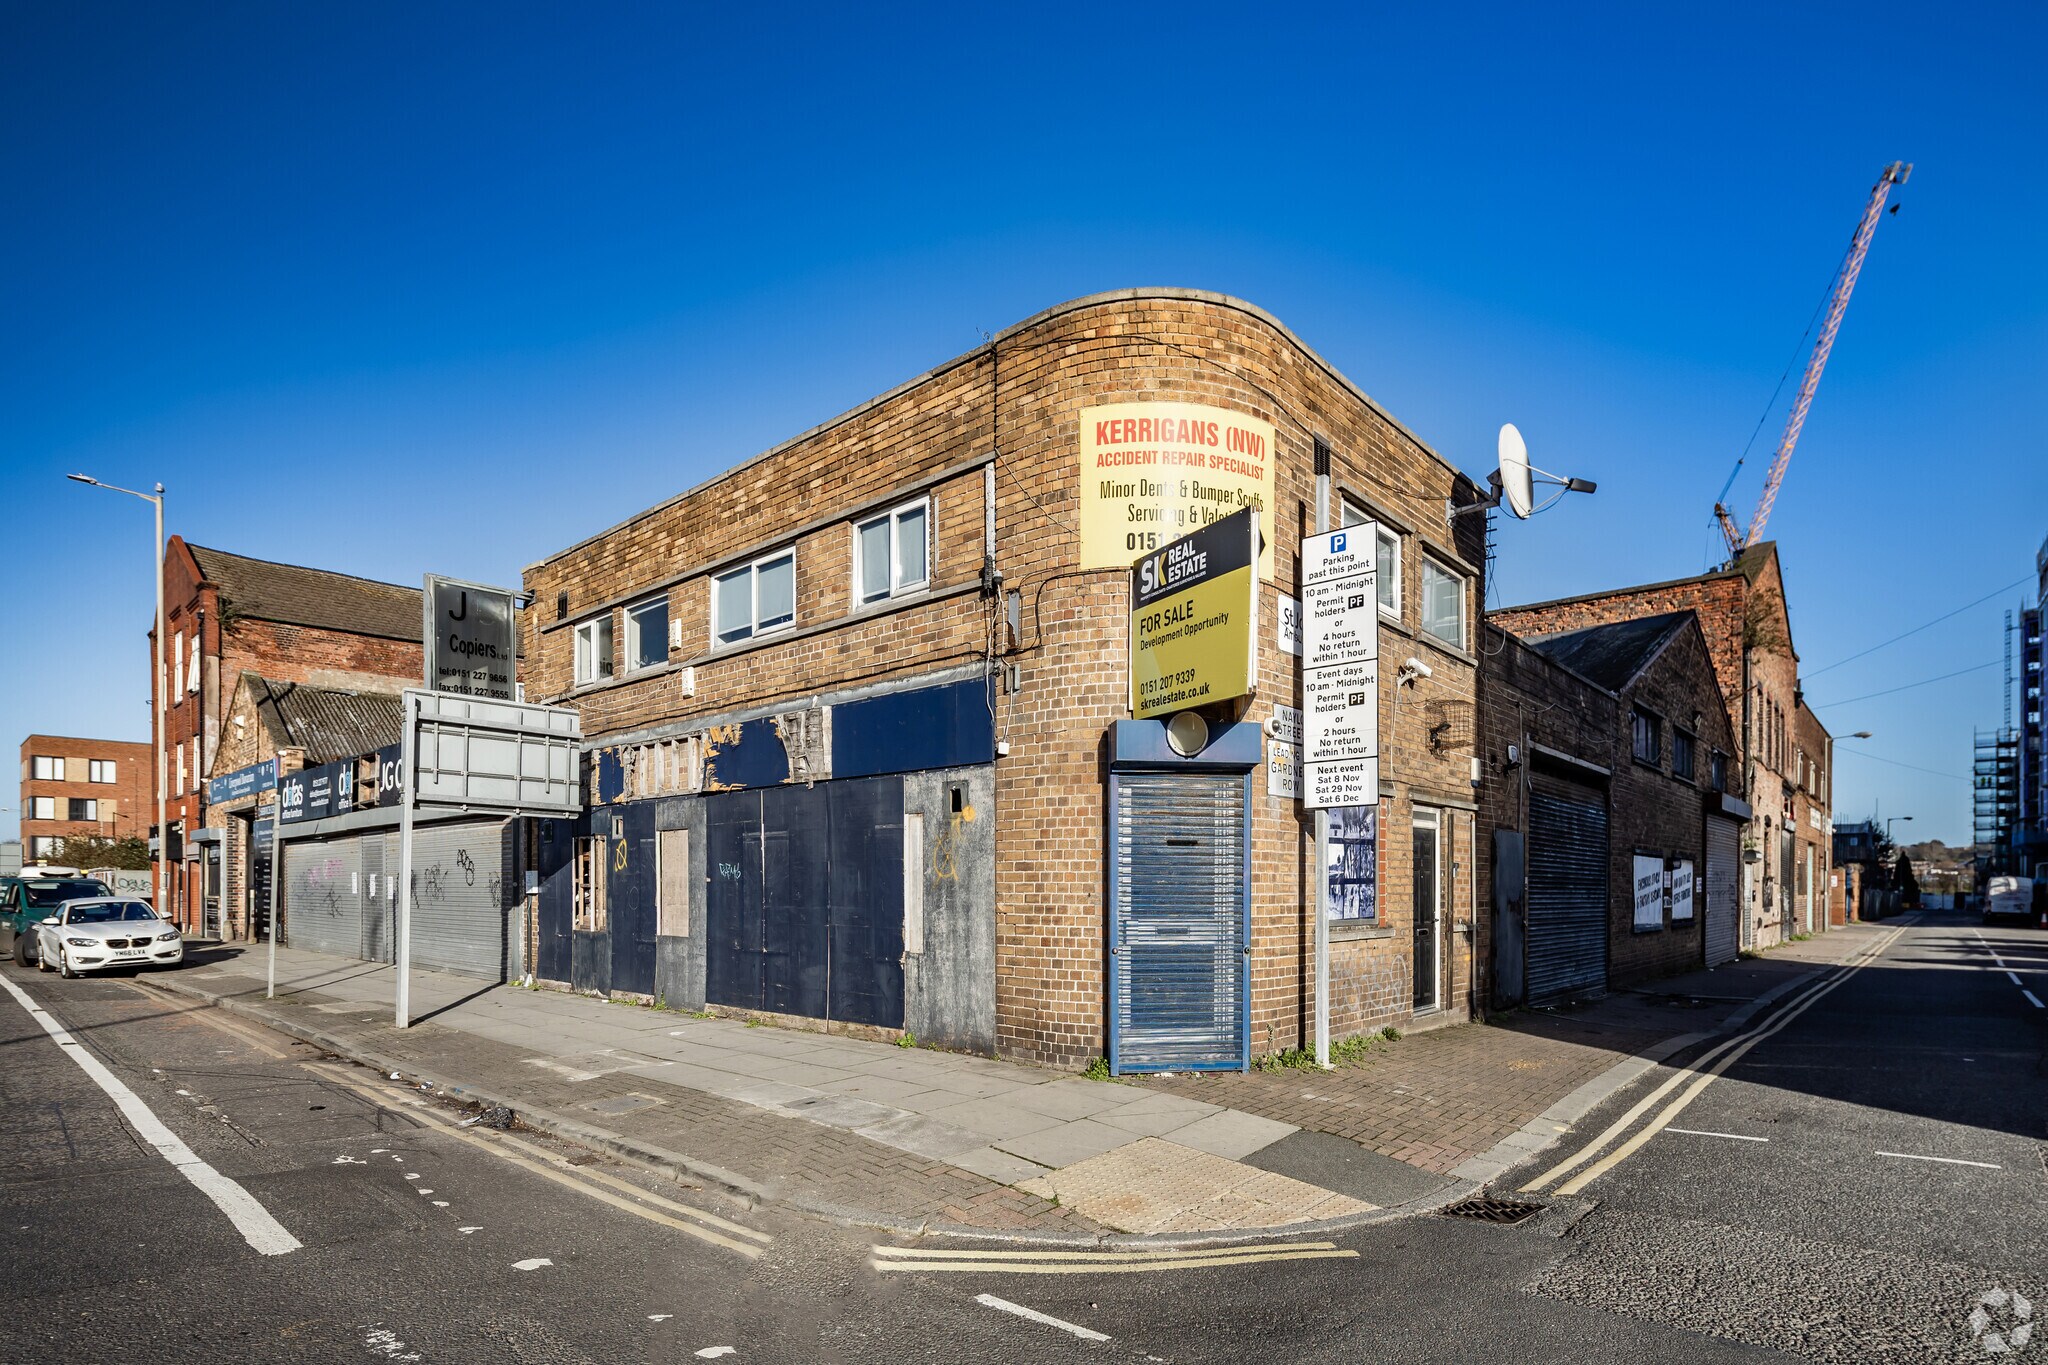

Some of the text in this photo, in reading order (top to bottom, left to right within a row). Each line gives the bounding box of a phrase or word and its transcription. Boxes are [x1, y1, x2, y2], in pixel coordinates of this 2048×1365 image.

[1096, 417, 1265, 462] KERRIGANS (NW)
[1096, 450, 1264, 481] ACCIDENT REPAIR SPECIALIST
[1100, 478, 1264, 513] Minor Dents & Bumper Scuffs
[1189, 503, 1198, 524] &
[1126, 532, 1165, 551] 0151
[1334, 535, 1345, 551] P
[1168, 539, 1196, 566] REAL
[1168, 550, 1207, 583] ESTATE
[1322, 553, 1355, 567] Parking
[1140, 550, 1168, 595] SK
[1308, 559, 1370, 580] past this point
[1305, 589, 1315, 598] 10
[1316, 587, 1329, 595] am
[1336, 577, 1374, 593] Midnight
[448, 591, 467, 622] J
[1316, 596, 1344, 608] Permit
[1350, 597, 1363, 607] PF
[1140, 599, 1194, 636] FOR SALE
[1284, 607, 1294, 628] St
[1314, 606, 1346, 618] holders
[1334, 619, 1343, 627] or
[1140, 612, 1229, 651] Development Opportunity
[1323, 629, 1356, 641] 4 hours
[449, 633, 497, 660] Copiers
[1319, 639, 1361, 652] No return
[1312, 652, 1340, 663] within
[1347, 648, 1367, 659] hour
[473, 671, 487, 681] 227
[489, 673, 508, 684] 9656
[1316, 665, 1364, 680] Event days
[1140, 668, 1196, 696] 0151 207 9339
[1305, 683, 1315, 692] 10
[1316, 682, 1329, 690] am
[1336, 675, 1375, 689] Midnight
[474, 687, 488, 697] 227
[490, 688, 509, 699] 9555
[1140, 682, 1210, 711] skrealestate.co.uk
[1316, 692, 1345, 703] Permit
[1351, 694, 1364, 704] PF
[1315, 702, 1346, 714] holders
[1335, 715, 1344, 723] or
[1278, 723, 1303, 740] STREE
[1323, 725, 1356, 737] 2 hours
[1319, 736, 1361, 747] No return
[1273, 747, 1300, 761] LEADNG
[1313, 747, 1340, 758] within
[1347, 744, 1368, 755] hour
[1317, 763, 1364, 774] Next event
[1282, 779, 1300, 792] ROW
[1317, 774, 1360, 784] Sat 8 Nov
[1315, 784, 1363, 794] Sat 29 Nov
[1318, 793, 1359, 804] Sat 6 Dec
[133, 948, 146, 956] LVA
